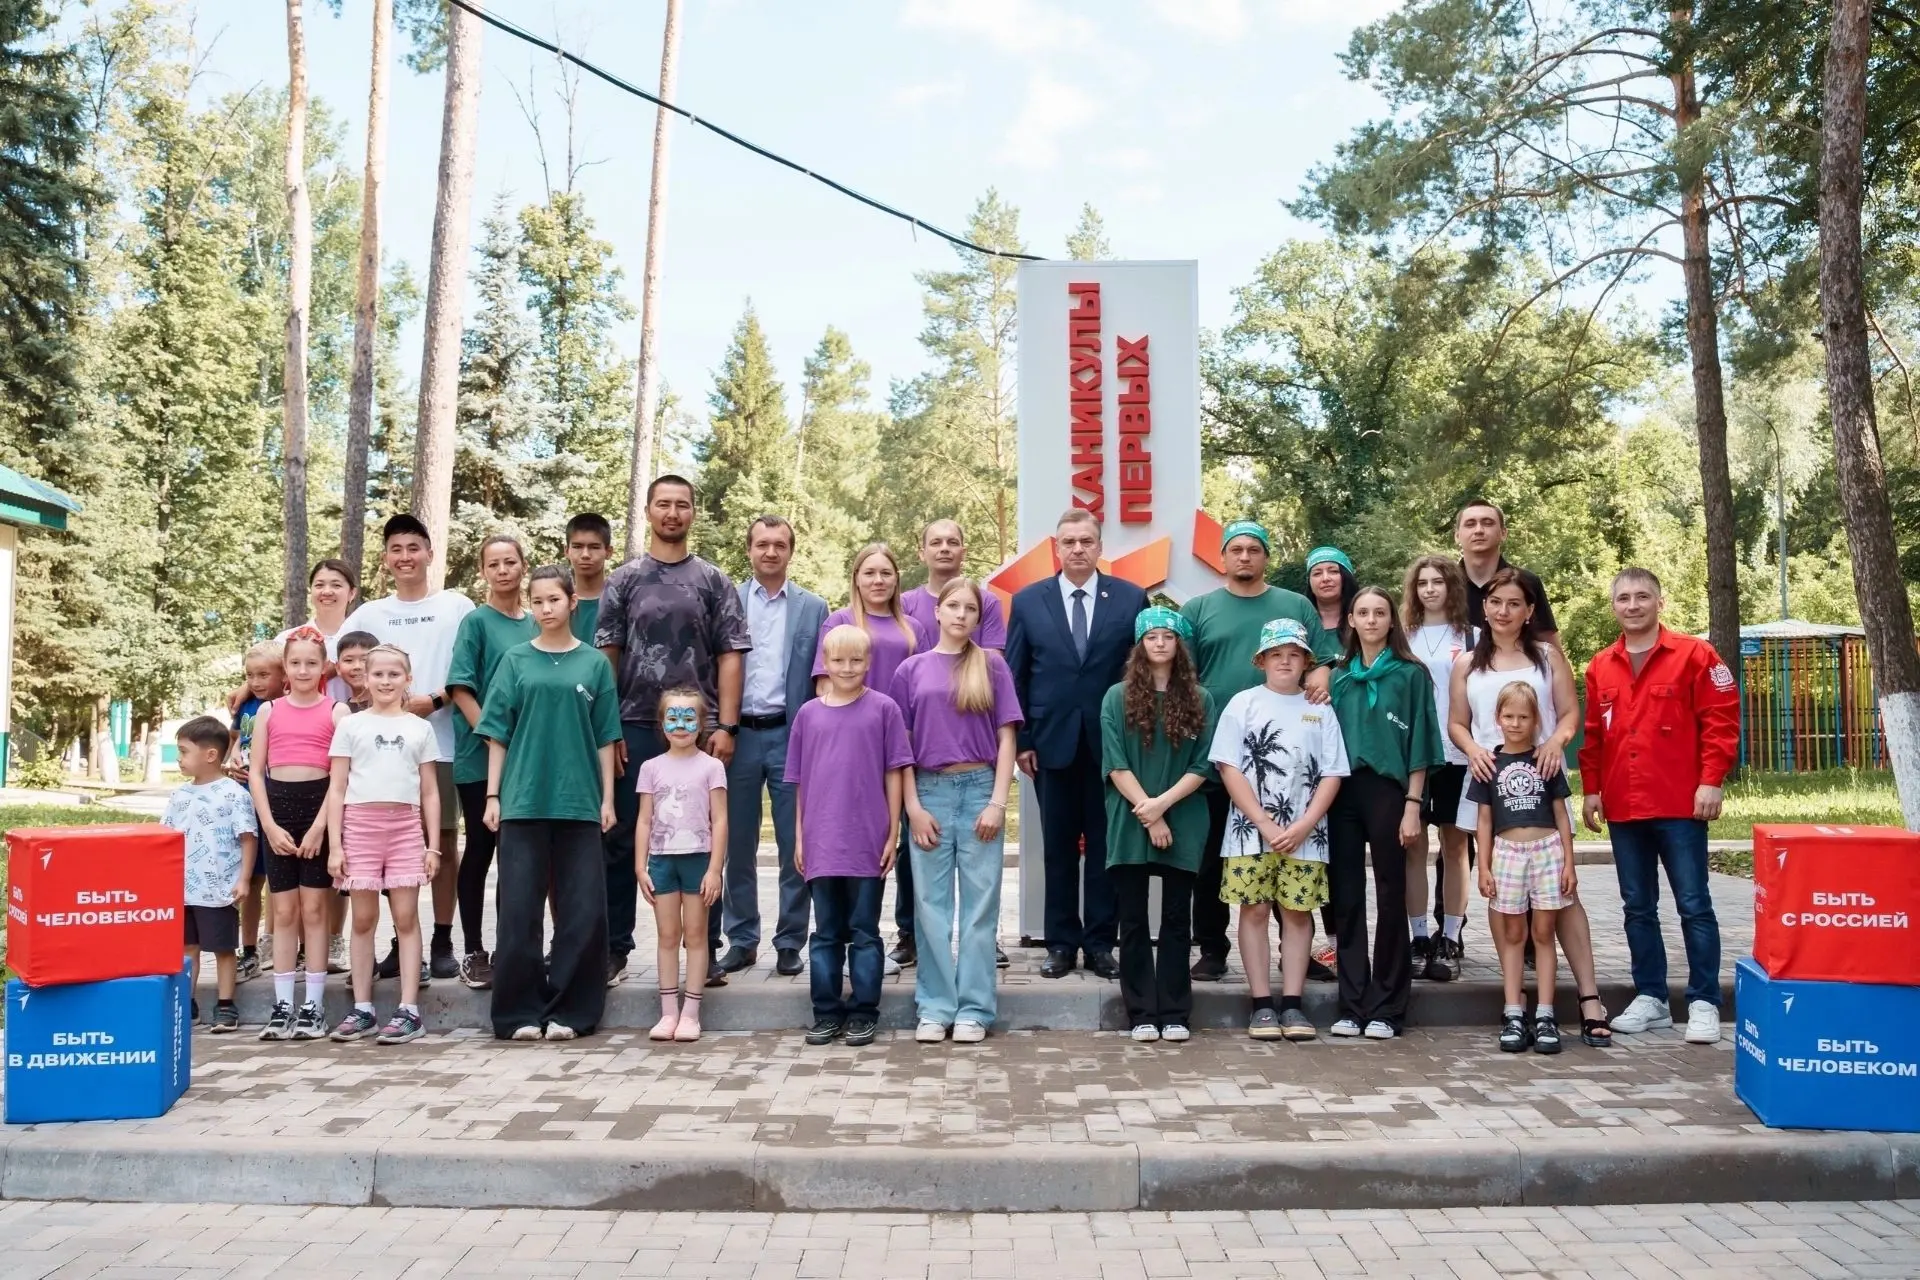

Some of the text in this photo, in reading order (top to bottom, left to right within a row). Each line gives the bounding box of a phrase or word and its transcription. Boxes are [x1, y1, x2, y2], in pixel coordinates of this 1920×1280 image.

[1069, 282, 1104, 523] КАНИКУЛЫ
[1117, 335, 1152, 523] ПЕРВЫХ
[388, 618, 402, 626] FREE
[405, 617, 419, 625] YOUR
[1496, 781, 1545, 796] 19 92
[1510, 776, 1530, 789] NYC
[1503, 798, 1541, 808] UNIVERSITY
[1510, 803, 1536, 812] LEAGUE
[77, 890, 138, 905] БЫТЬ
[1812, 892, 1876, 907] БЫТЬ
[36, 907, 175, 927] ЧЕЛОВЕКОМ
[1781, 911, 1908, 929] С РОССИЕЙ
[1745, 1018, 1759, 1039] БЫТЬ
[53, 1031, 114, 1046] БЫТЬ
[1817, 1038, 1879, 1054] БЫТЬ
[1738, 1033, 1766, 1067] С РОССИЕЙ
[8, 1050, 156, 1069] В ДВИЖЕНИИ
[1778, 1056, 1917, 1077] ЧЕЛОВЕКОМ
